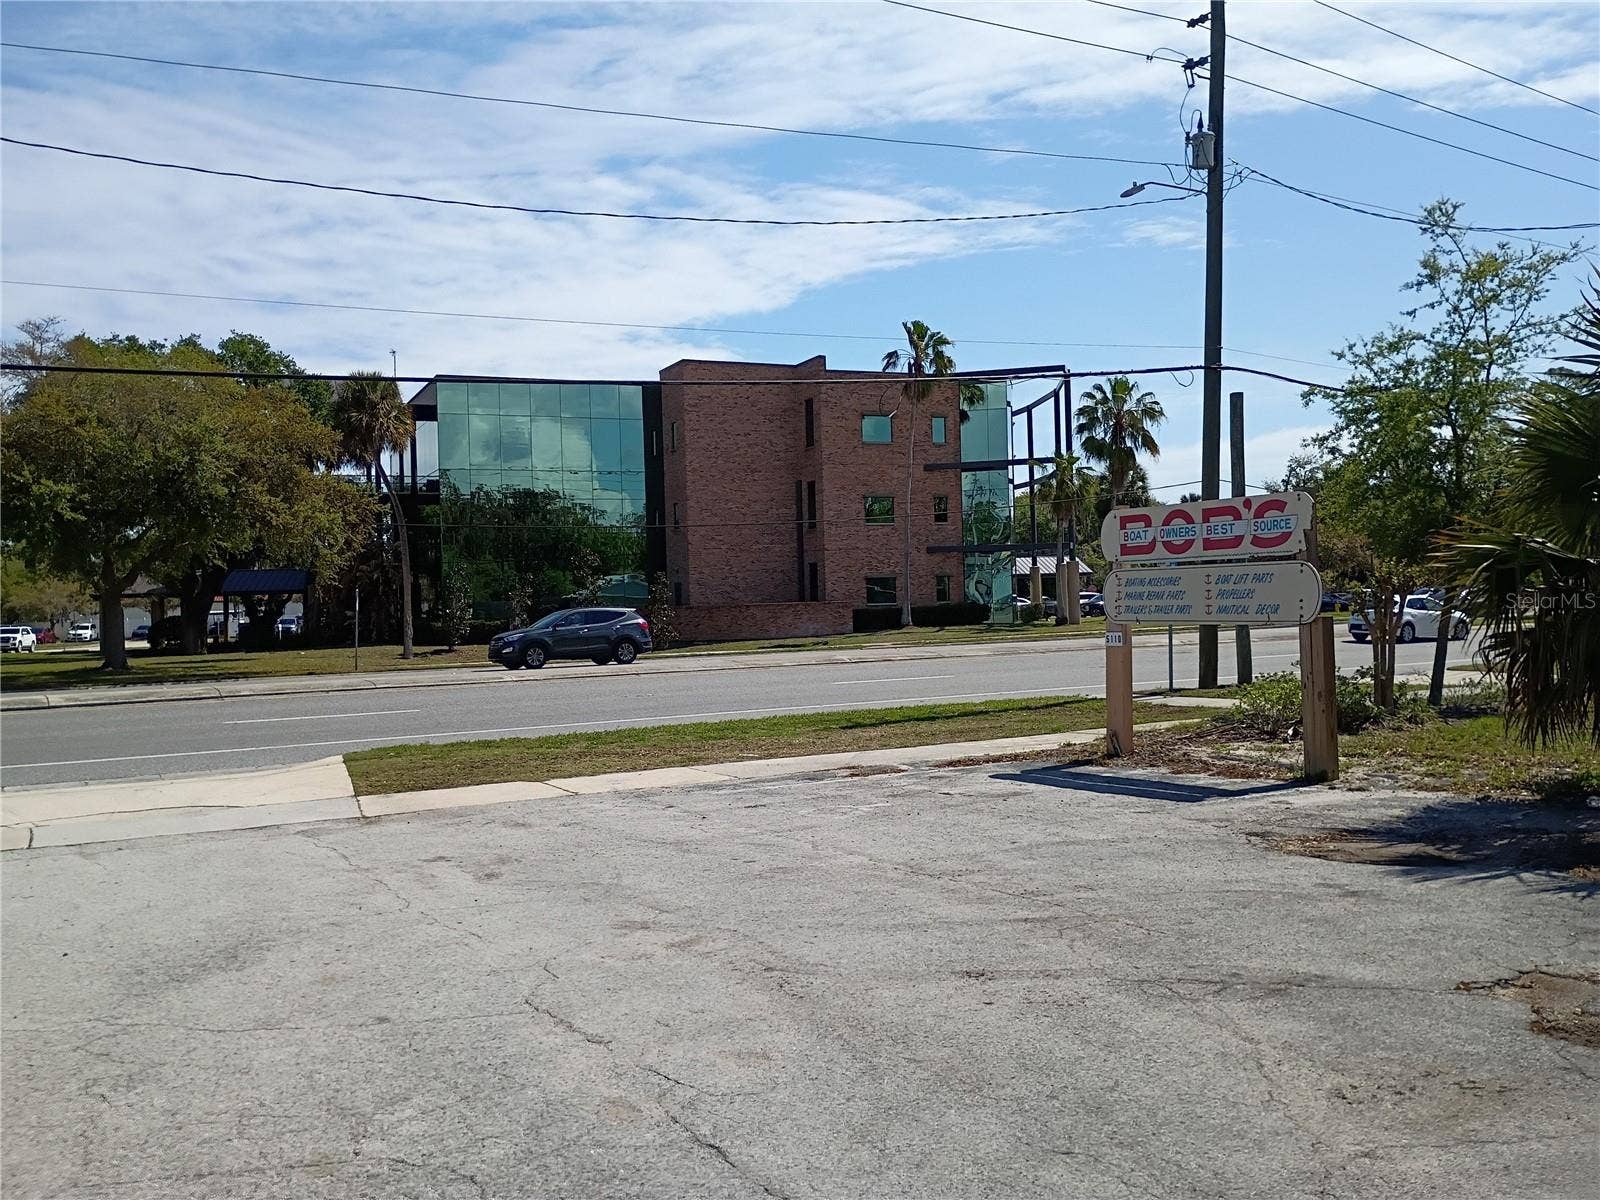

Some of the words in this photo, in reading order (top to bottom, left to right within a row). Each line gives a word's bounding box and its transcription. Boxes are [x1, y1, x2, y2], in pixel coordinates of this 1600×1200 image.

[1119, 498, 1293, 556] BOB'S
[1123, 529, 1149, 542] BOAT
[1159, 525, 1197, 539] OWNERS
[1206, 522, 1235, 535] BEST
[1252, 518, 1292, 532] SOURCE
[1124, 577, 1146, 588] BOATING
[1215, 574, 1234, 585] BOAT
[1233, 573, 1250, 584] LIFT
[1250, 572, 1274, 584] PARTS
[1124, 591, 1146, 601] MARINE
[1145, 590, 1167, 601] REPAIR
[1165, 590, 1186, 601] PARTS
[1215, 588, 1256, 600] PROPELLERS
[1124, 604, 1148, 615] TRAILERS
[1153, 604, 1175, 615] TRAILER
[1174, 604, 1193, 615] PARTS
[1215, 604, 1250, 615] NAUTICAL
[1255, 603, 1281, 615] DECOR
